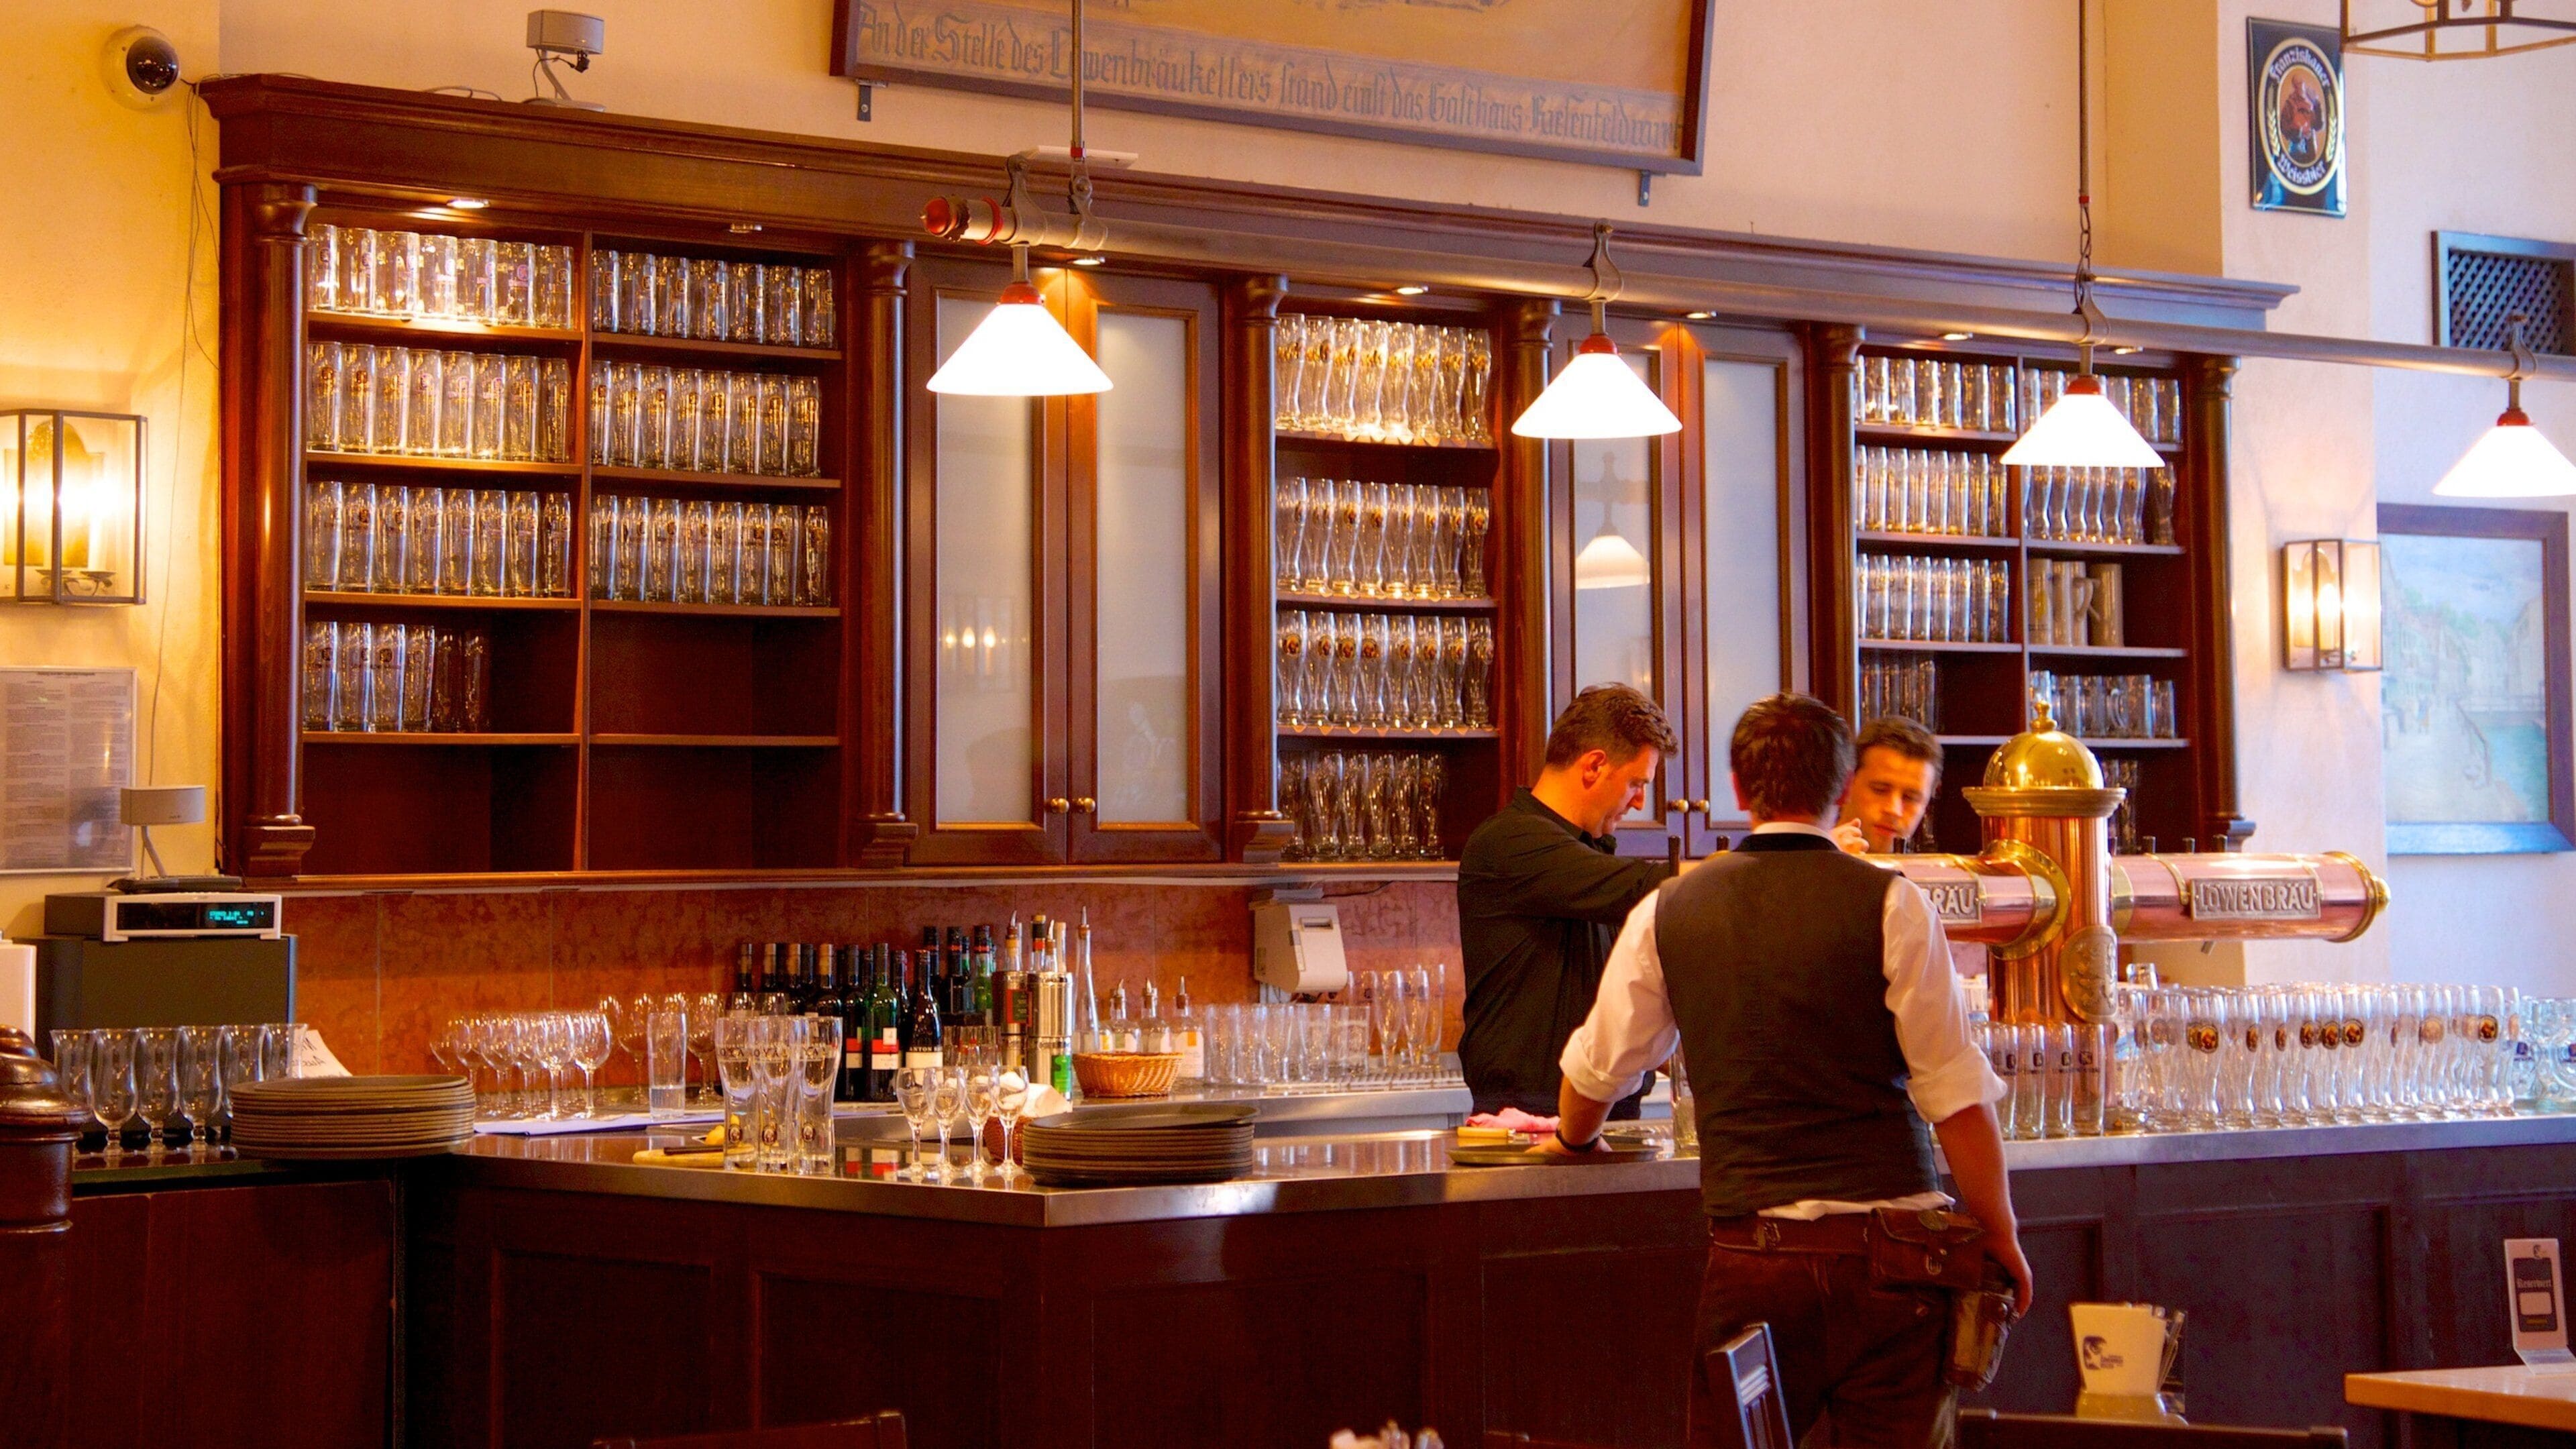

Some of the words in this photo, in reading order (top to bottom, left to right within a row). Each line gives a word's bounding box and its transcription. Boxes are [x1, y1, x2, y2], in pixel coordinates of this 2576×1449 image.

[932, 12, 1005, 70] Stelle
[1006, 15, 1044, 74] des
[1049, 26, 1271, 102] Lwenbräukellers
[2197, 882, 2314, 912] LÖWENBRÄU
